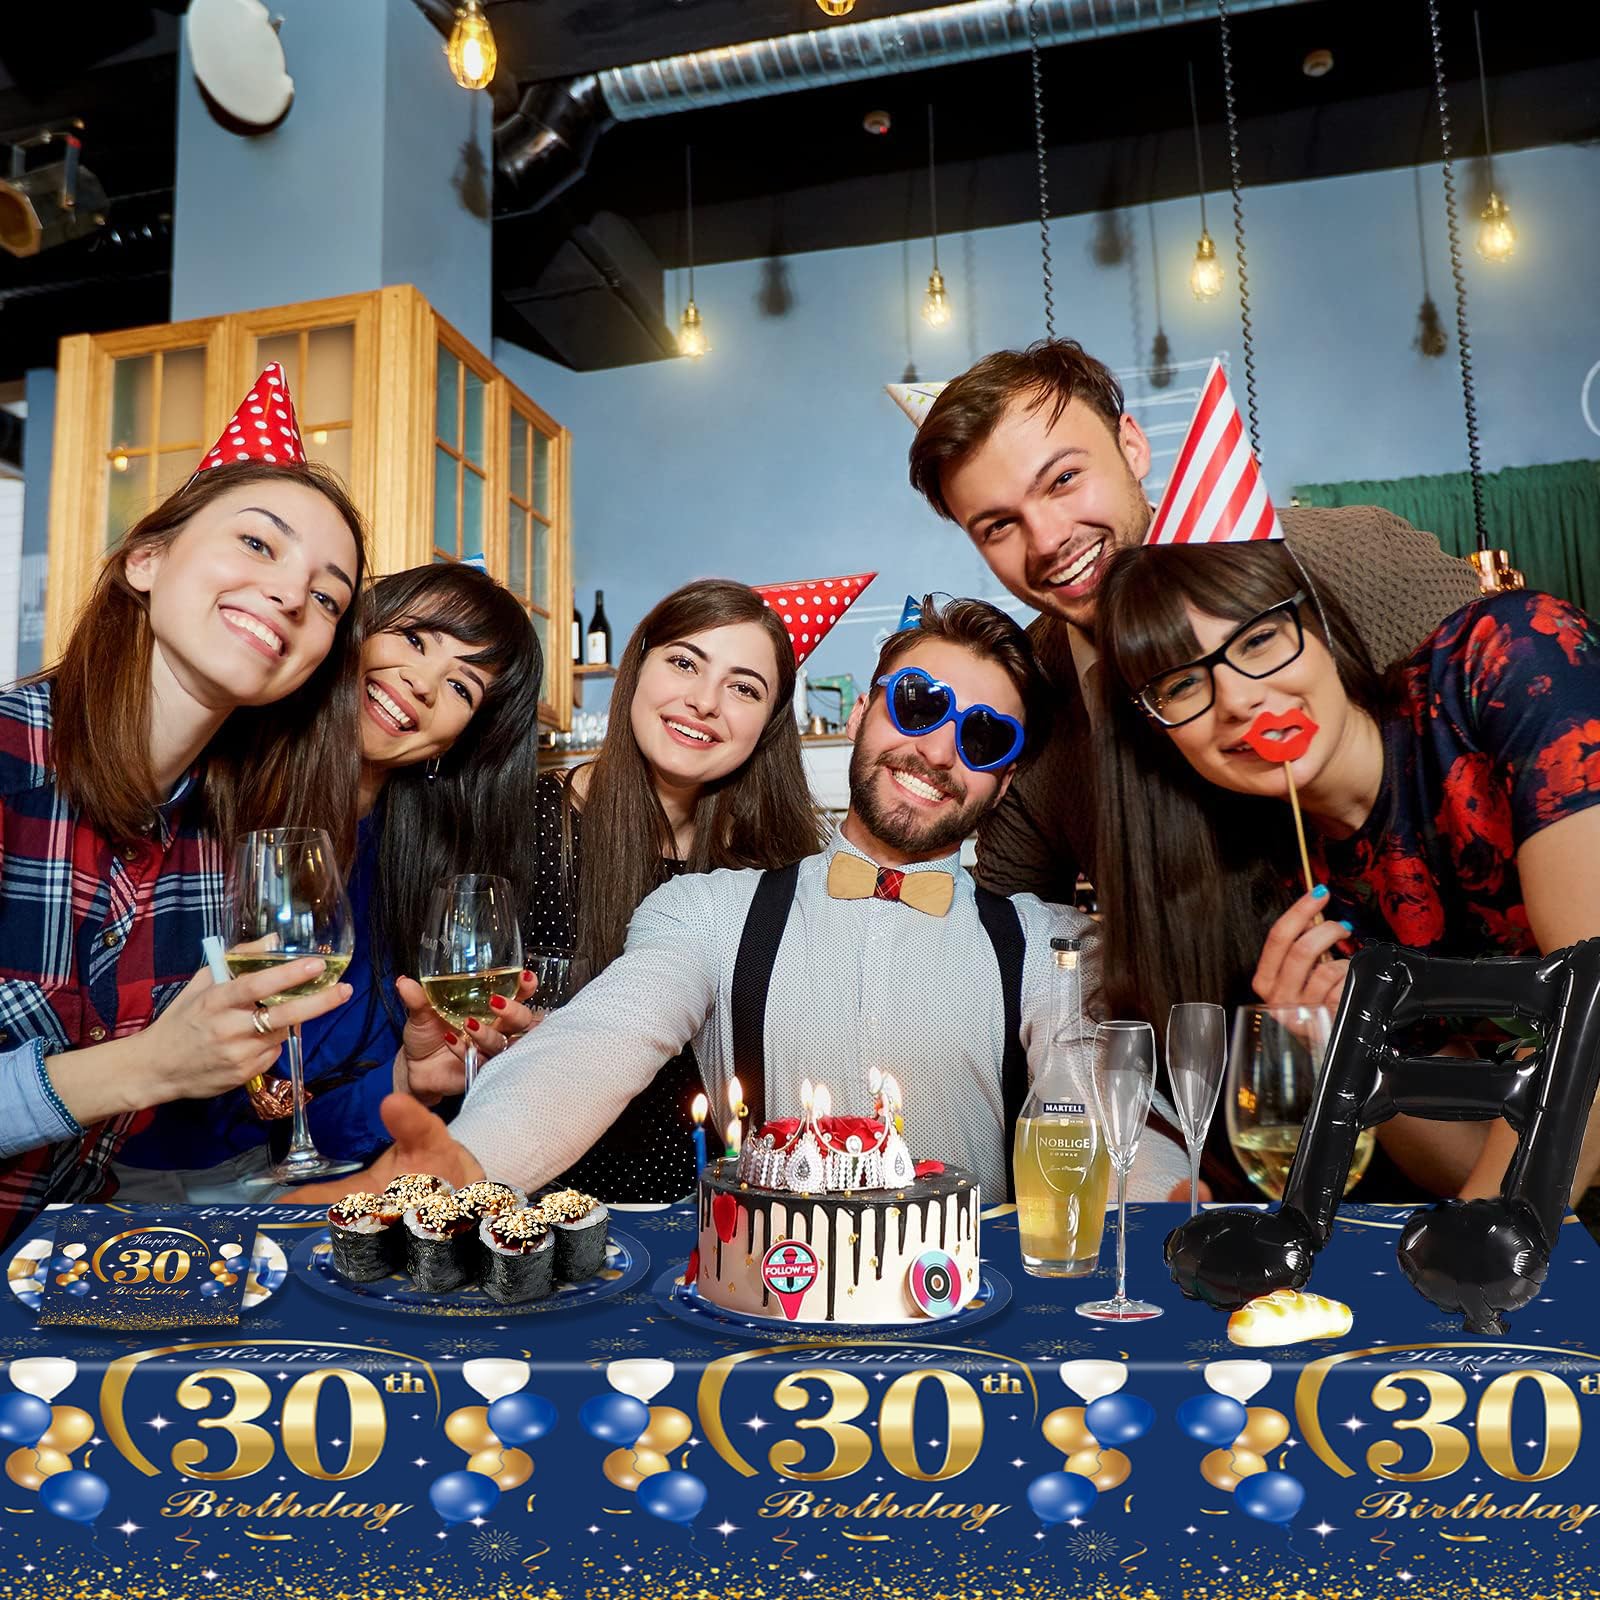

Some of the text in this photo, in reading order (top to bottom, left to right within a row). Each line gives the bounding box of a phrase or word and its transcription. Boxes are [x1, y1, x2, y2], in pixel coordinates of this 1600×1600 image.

[1045, 1104, 1083, 1112] MARTELL
[1039, 1137, 1090, 1149] NOBLIGE
[128, 1234, 181, 1248] Happy
[765, 1265, 816, 1276] FOLLOW ME
[106, 1286, 192, 1298] Birthday
[194, 1347, 348, 1363] Happy
[793, 1349, 946, 1364] Happy
[1390, 1350, 1542, 1365] Happy
[160, 1489, 415, 1531] Birthday
[757, 1490, 1012, 1531] Birthday
[1354, 1491, 1600, 1532] Birthday
